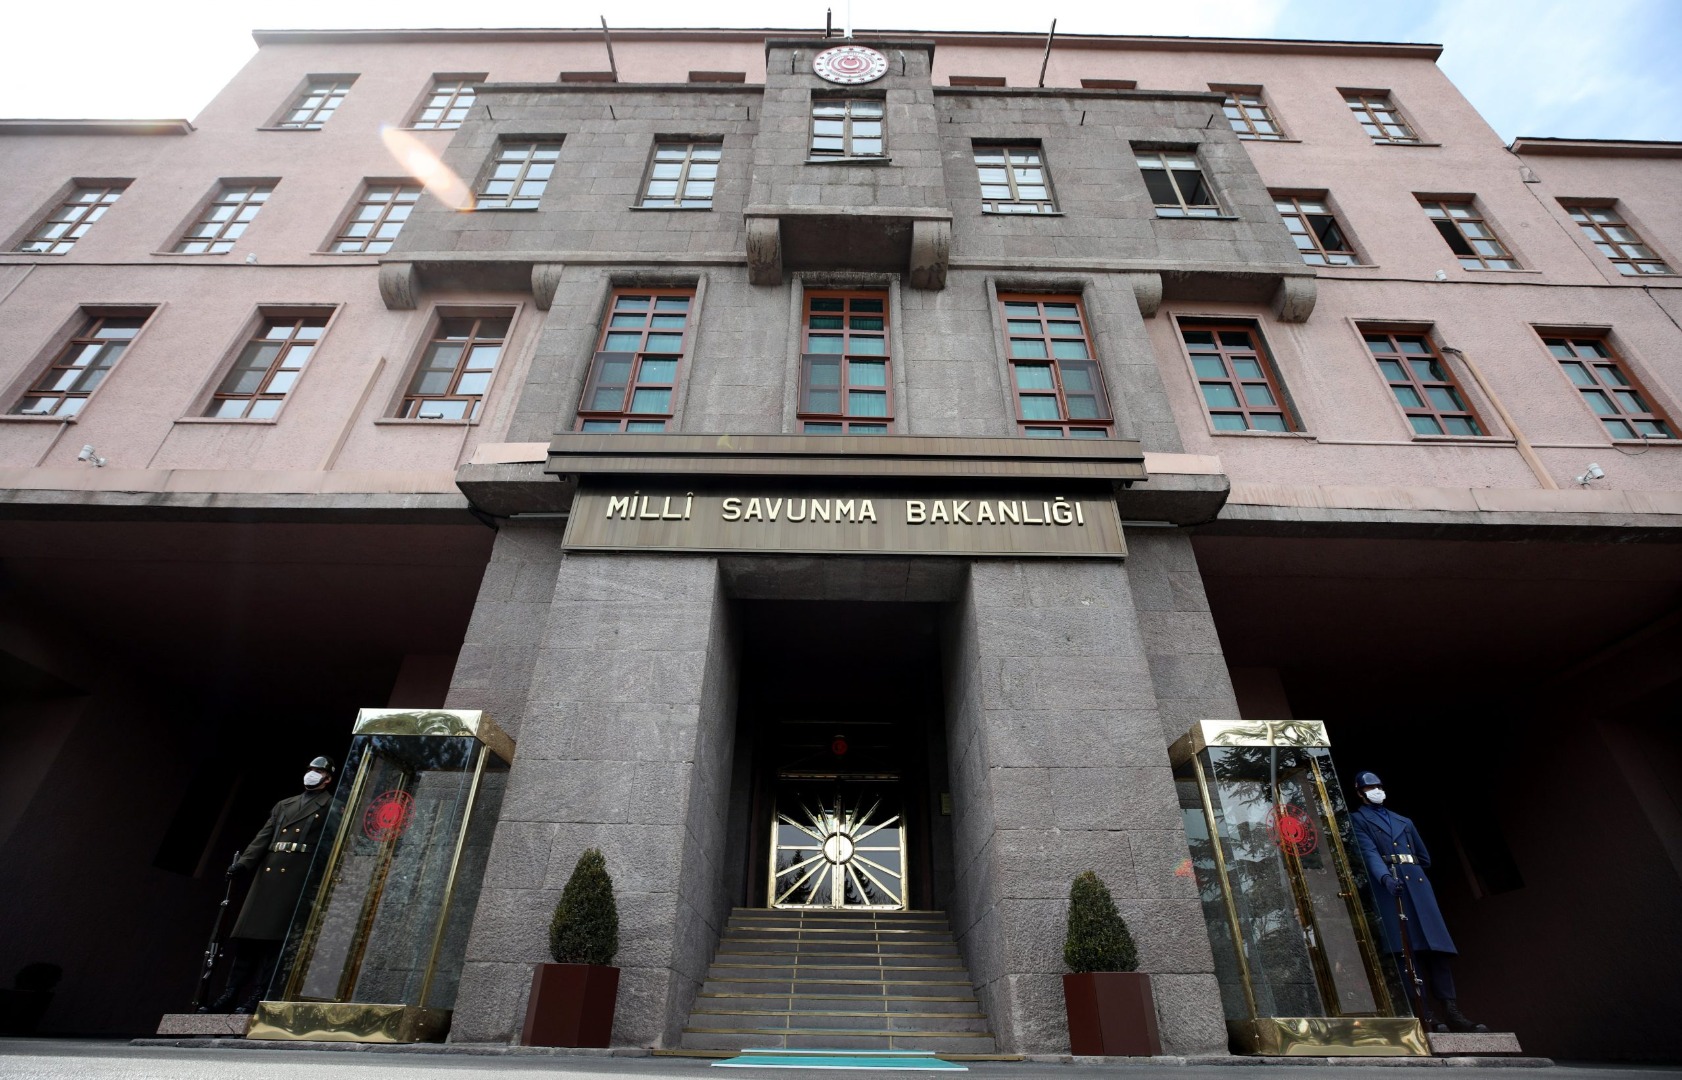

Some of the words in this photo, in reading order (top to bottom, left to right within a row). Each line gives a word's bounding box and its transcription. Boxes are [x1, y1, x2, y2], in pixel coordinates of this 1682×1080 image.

[605, 490, 694, 520] MİLLÎ
[722, 497, 877, 523] SAVUNMA
[906, 496, 1084, 526] BAKANLIĞI
